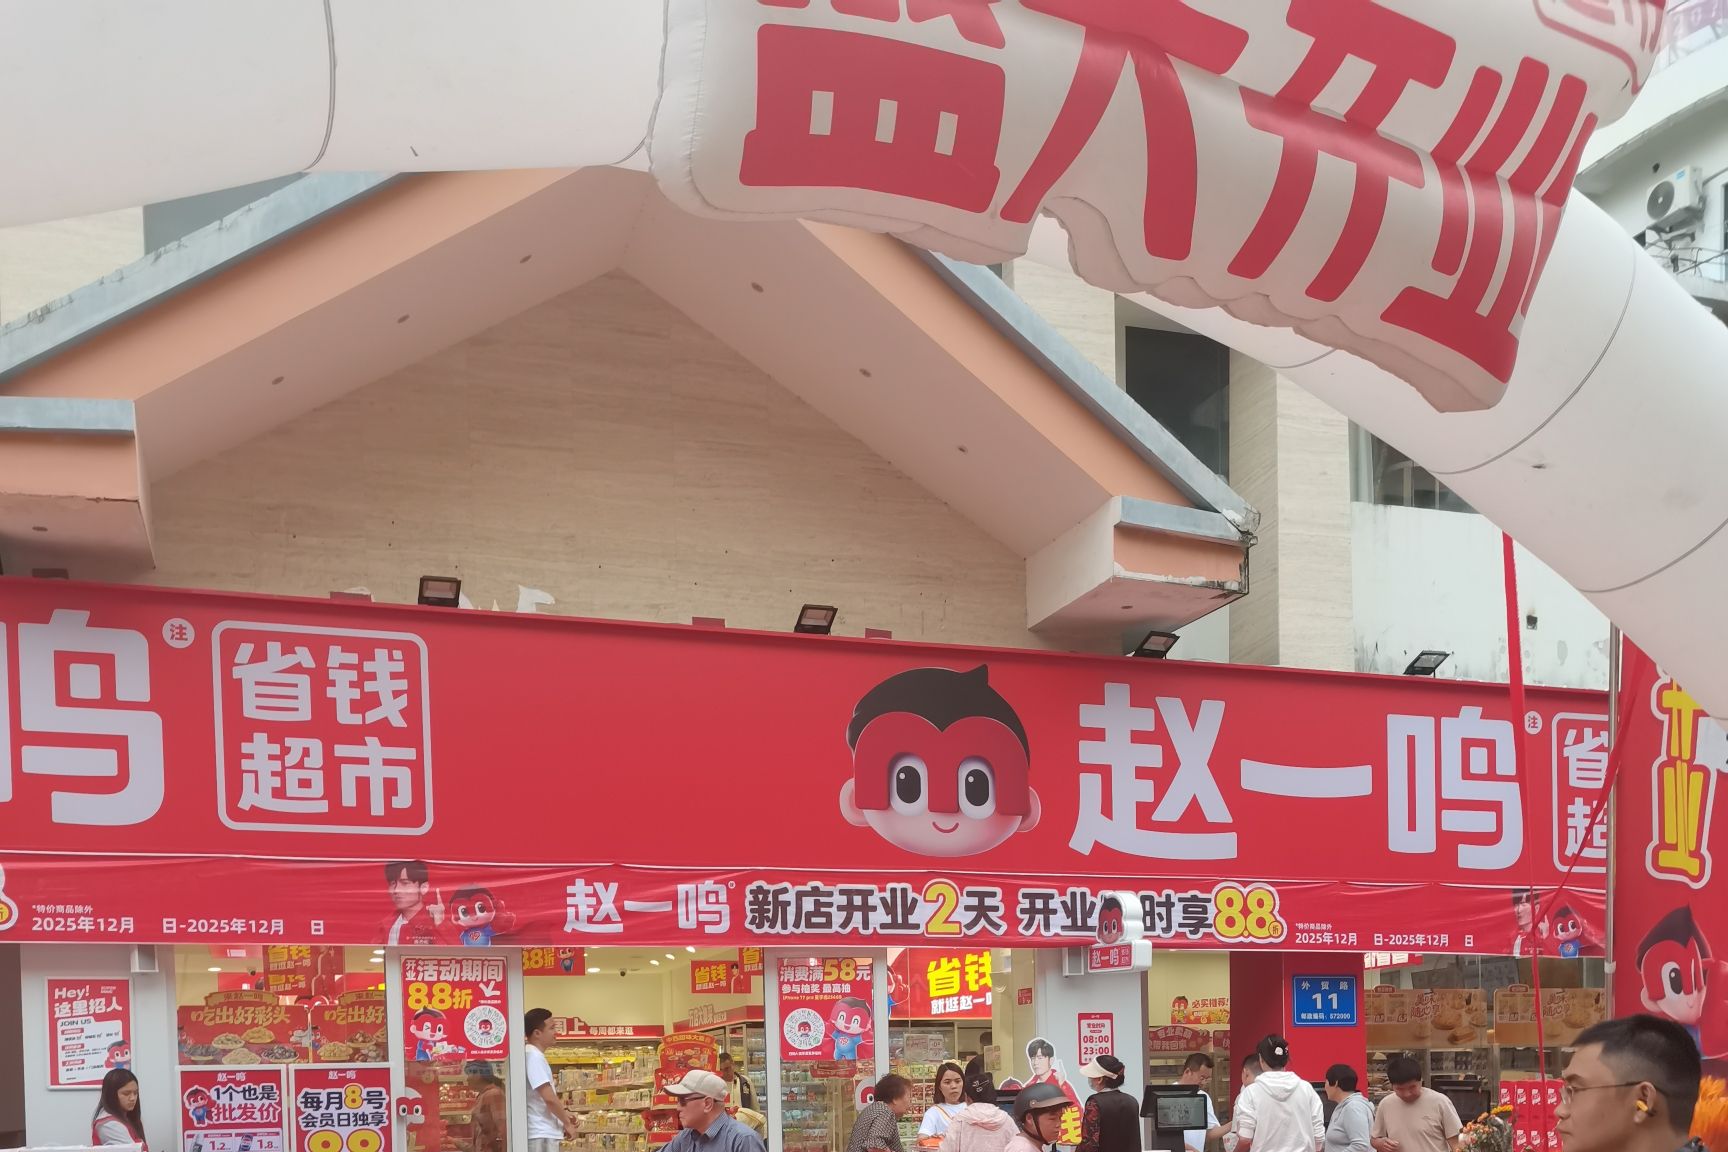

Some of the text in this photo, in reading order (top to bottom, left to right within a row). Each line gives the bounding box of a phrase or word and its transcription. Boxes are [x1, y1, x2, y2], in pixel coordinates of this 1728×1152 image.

[232, 641, 409, 727] 省钱
[238, 732, 416, 816] 超市
[1068, 682, 1524, 870] 赵一鸣
[563, 878, 1284, 939] 赵一鸣 新店开业2天 开业时享8.8折
[32, 916, 324, 935] 2025年12月 日-2025年12月 日
[1295, 932, 1474, 947] 2025年12月 日-2025年12月 日
[742, 948, 762, 965] 省
[417, 959, 503, 981] 活动期间
[695, 964, 726, 985] 省钱
[780, 958, 871, 982] 消费满58元
[927, 951, 991, 997] 省钱
[54, 985, 90, 1000] Hey!
[1301, 980, 1348, 990] 外贸路
[54, 996, 123, 1018] 这里招人
[1312, 993, 1337, 1009] 11
[60, 1019, 79, 1027] JOIN
[1083, 1035, 1109, 1043] 08:00
[1083, 1046, 1109, 1055] 23:00
[213, 1085, 279, 1102] 1个也是
[300, 1083, 386, 1111] 每月8号
[214, 1103, 280, 1122] 批发价
[301, 1111, 387, 1128] 会员日独享
[209, 1140, 226, 1151] 1.2
[257, 1139, 273, 1149] 1.8
